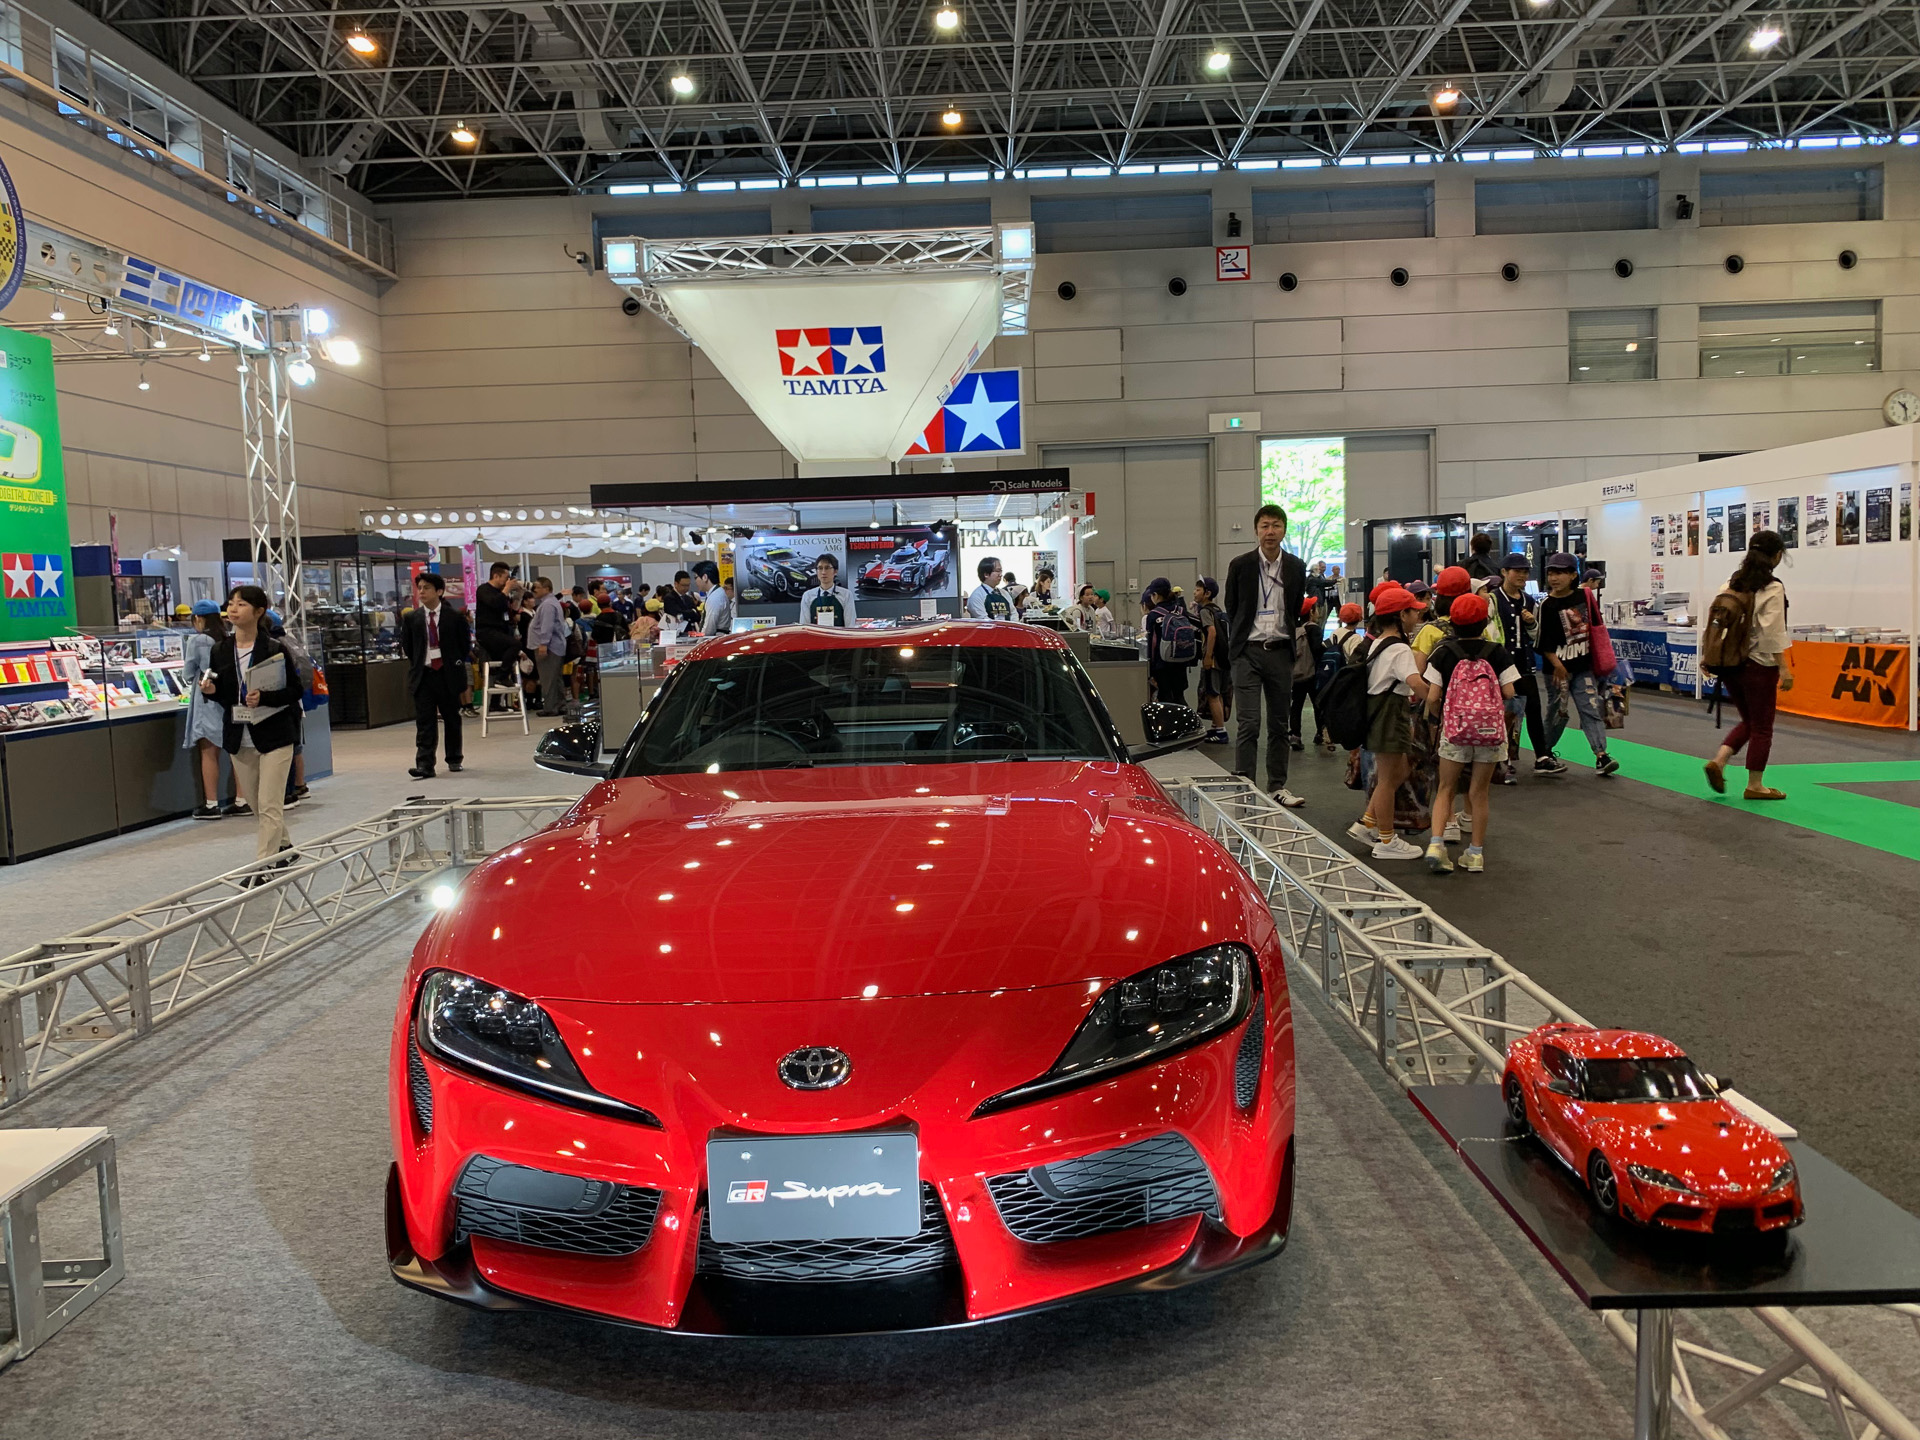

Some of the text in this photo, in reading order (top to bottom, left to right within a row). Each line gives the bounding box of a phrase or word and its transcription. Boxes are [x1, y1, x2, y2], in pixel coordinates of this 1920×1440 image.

[783, 377, 888, 396] TAMIYA
[1008, 479, 1063, 490] Scale Models
[789, 538, 810, 546] LEON
[824, 544, 842, 552] AMG
[6, 600, 67, 618] TAMIYA
[729, 1180, 901, 1208] GR Supra
